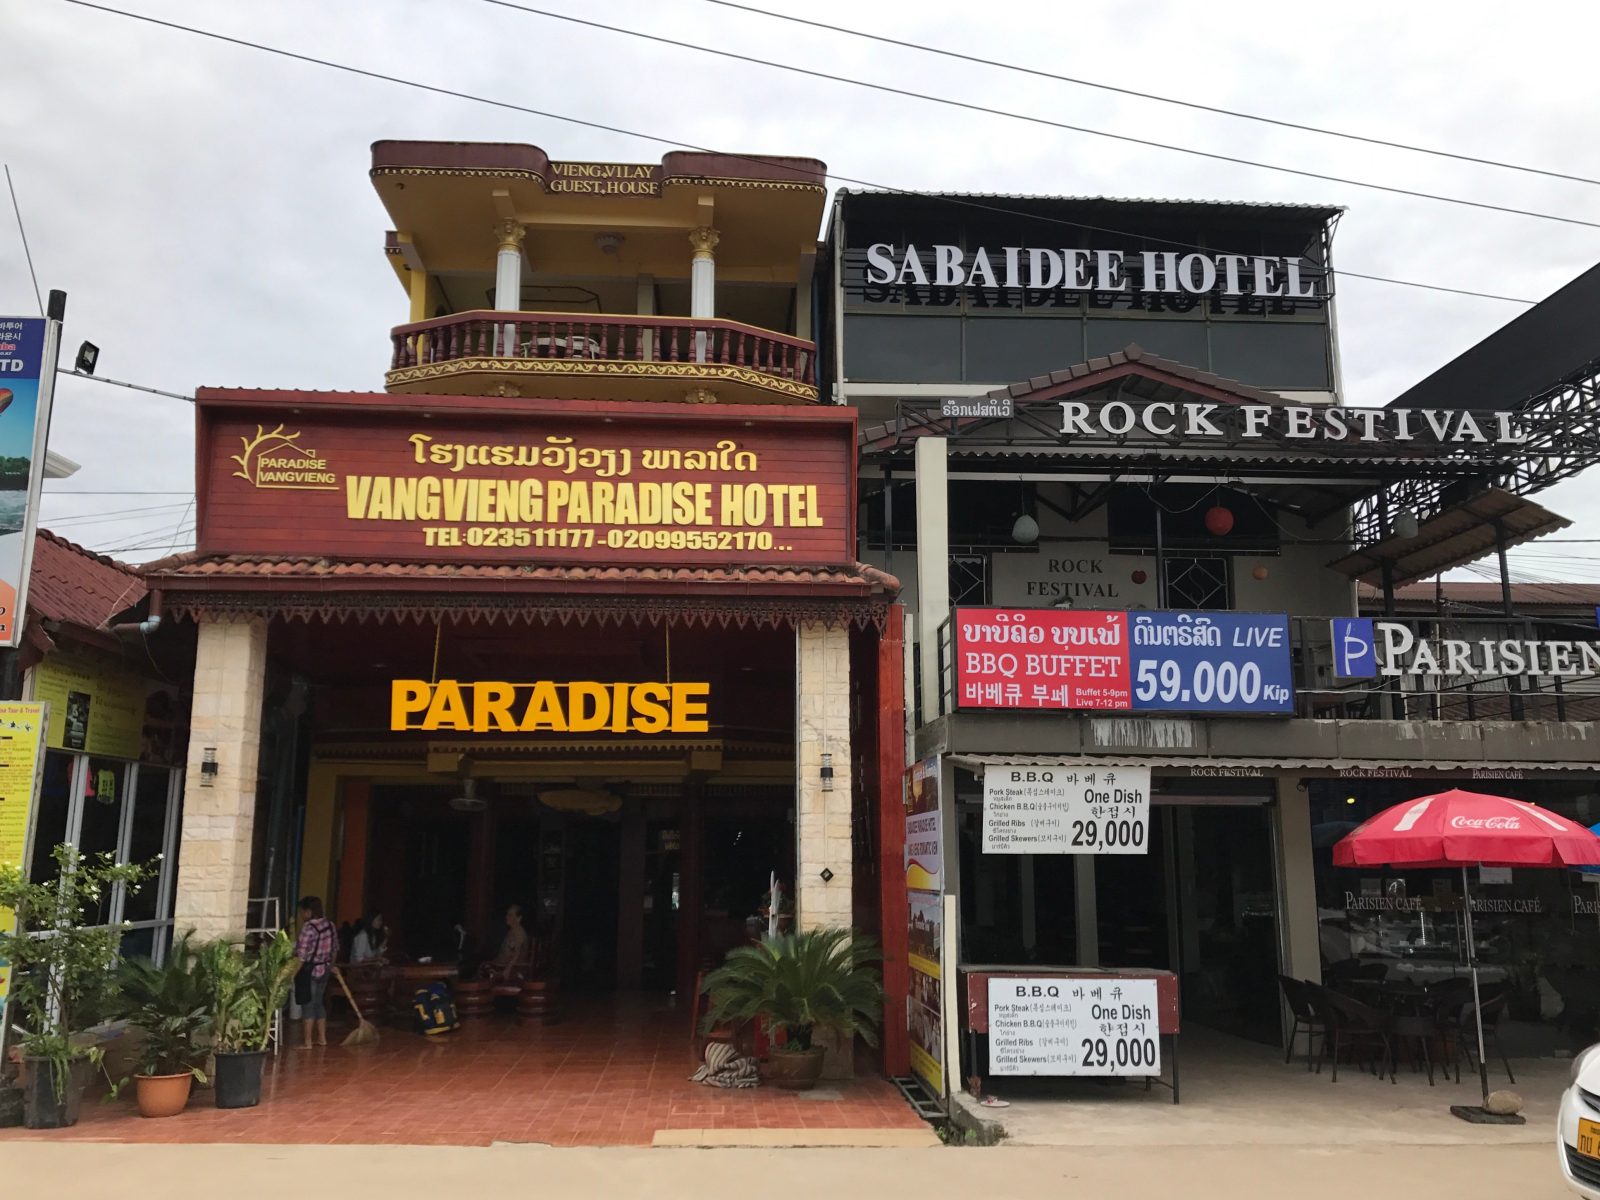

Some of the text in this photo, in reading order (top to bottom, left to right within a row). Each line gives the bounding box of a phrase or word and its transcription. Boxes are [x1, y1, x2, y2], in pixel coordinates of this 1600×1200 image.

[551, 164, 654, 178] VIENG VILAY
[550, 180, 602, 192] GUEST
[866, 243, 1315, 298] SABAIDEE HOTEL
[1058, 401, 1529, 443] ROCK FESTIVAL
[260, 457, 327, 470] PARADISE
[260, 471, 336, 484] VANGVIENG
[547, 480, 713, 526] PARADISE
[721, 483, 824, 527] HOTEL
[1047, 558, 1104, 574] ROCK
[1026, 581, 1119, 598] FESTIVAL
[1232, 626, 1284, 648] LIVE
[965, 652, 1121, 679] BBQ BUFFET
[1135, 659, 1290, 705] 59.000 Kip
[965, 682, 1069, 708] 바베큐 부페
[1075, 687, 1128, 699] Buffet 5-9pm
[390, 679, 710, 734] PARADISE
[1075, 698, 1128, 709] Live 7-12 pm
[1011, 771, 1054, 783] B.B.Q
[1190, 768, 1264, 777] ROCK FESTIVAL
[1340, 769, 1412, 777] ROCK FESTIVAL
[1472, 769, 1504, 779] PARISIEN
[989, 788, 1023, 796] Pork Steak
[1084, 788, 1142, 804] One Dish
[989, 802, 1016, 811] Chicken
[988, 819, 1026, 828] Grilled Ribs
[1451, 815, 1521, 830] Coca-Cola
[988, 834, 1010, 843] Grilled
[1071, 820, 1144, 851] 29,000
[1345, 891, 1394, 910] PARISIEN
[1514, 896, 1542, 913] CAFÉ
[1016, 985, 1060, 998] B.B.Q
[994, 1003, 1029, 1012] Pork Steak
[1091, 1004, 1151, 1020] One Dish
[995, 1019, 1022, 1028] Chicken
[995, 1037, 1034, 1047] Grilled Ribs
[995, 1055, 1047, 1064] Grilled Skewers
[1081, 1038, 1156, 1072] 29,000
